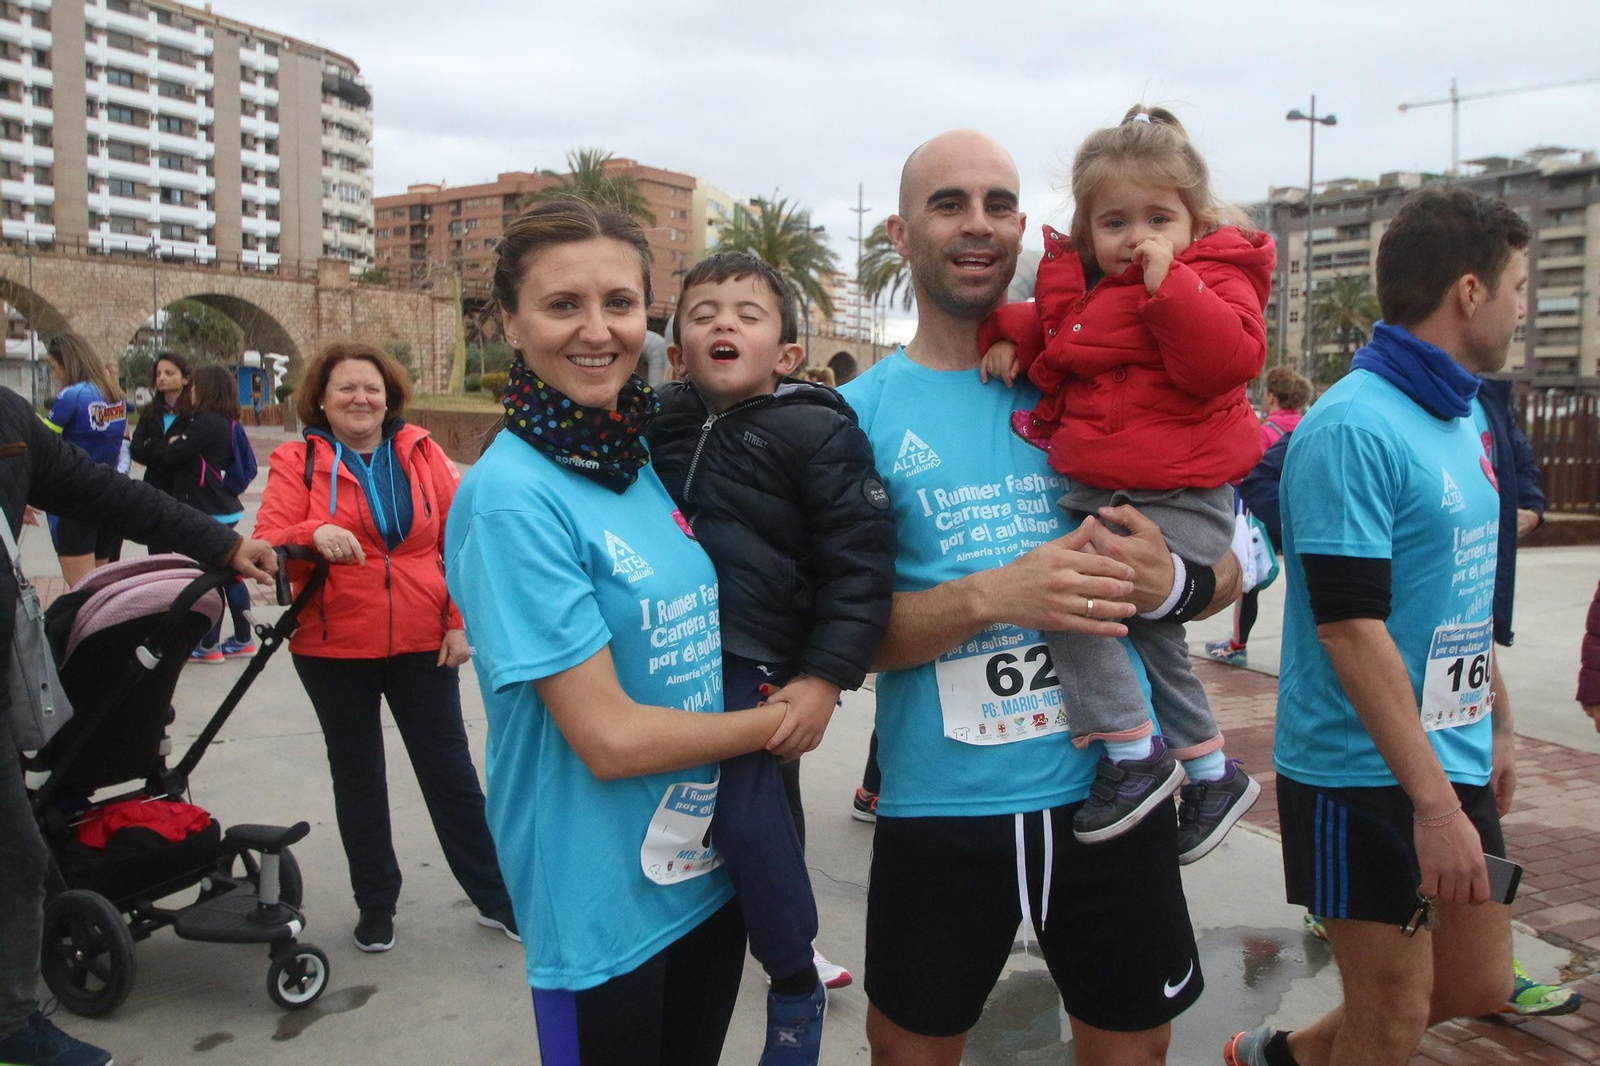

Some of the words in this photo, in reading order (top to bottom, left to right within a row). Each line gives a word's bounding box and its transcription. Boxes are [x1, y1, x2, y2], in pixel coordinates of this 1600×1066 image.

[743, 431, 769, 449] STREET
[893, 448, 939, 474] ALTEA
[917, 488, 933, 517] I
[934, 483, 1002, 510] Runner
[1005, 473, 1071, 494] Fashion
[935, 499, 1012, 531] Carrera
[1017, 493, 1050, 514] azul
[940, 531, 965, 555] por
[970, 523, 993, 543] el
[995, 514, 1058, 540] autismo
[612, 555, 649, 576] ALTEA
[956, 546, 993, 563] Almería
[639, 598, 651, 631] I
[657, 592, 698, 624] Runner
[651, 615, 706, 648] Carrera
[967, 639, 979, 653] el
[981, 632, 1024, 650] autismo
[649, 650, 678, 675] por
[683, 641, 698, 662] el
[666, 669, 700, 686] Almería
[982, 702, 1000, 719] PG:
[675, 801, 698, 812] por
[700, 802, 712, 814] el
